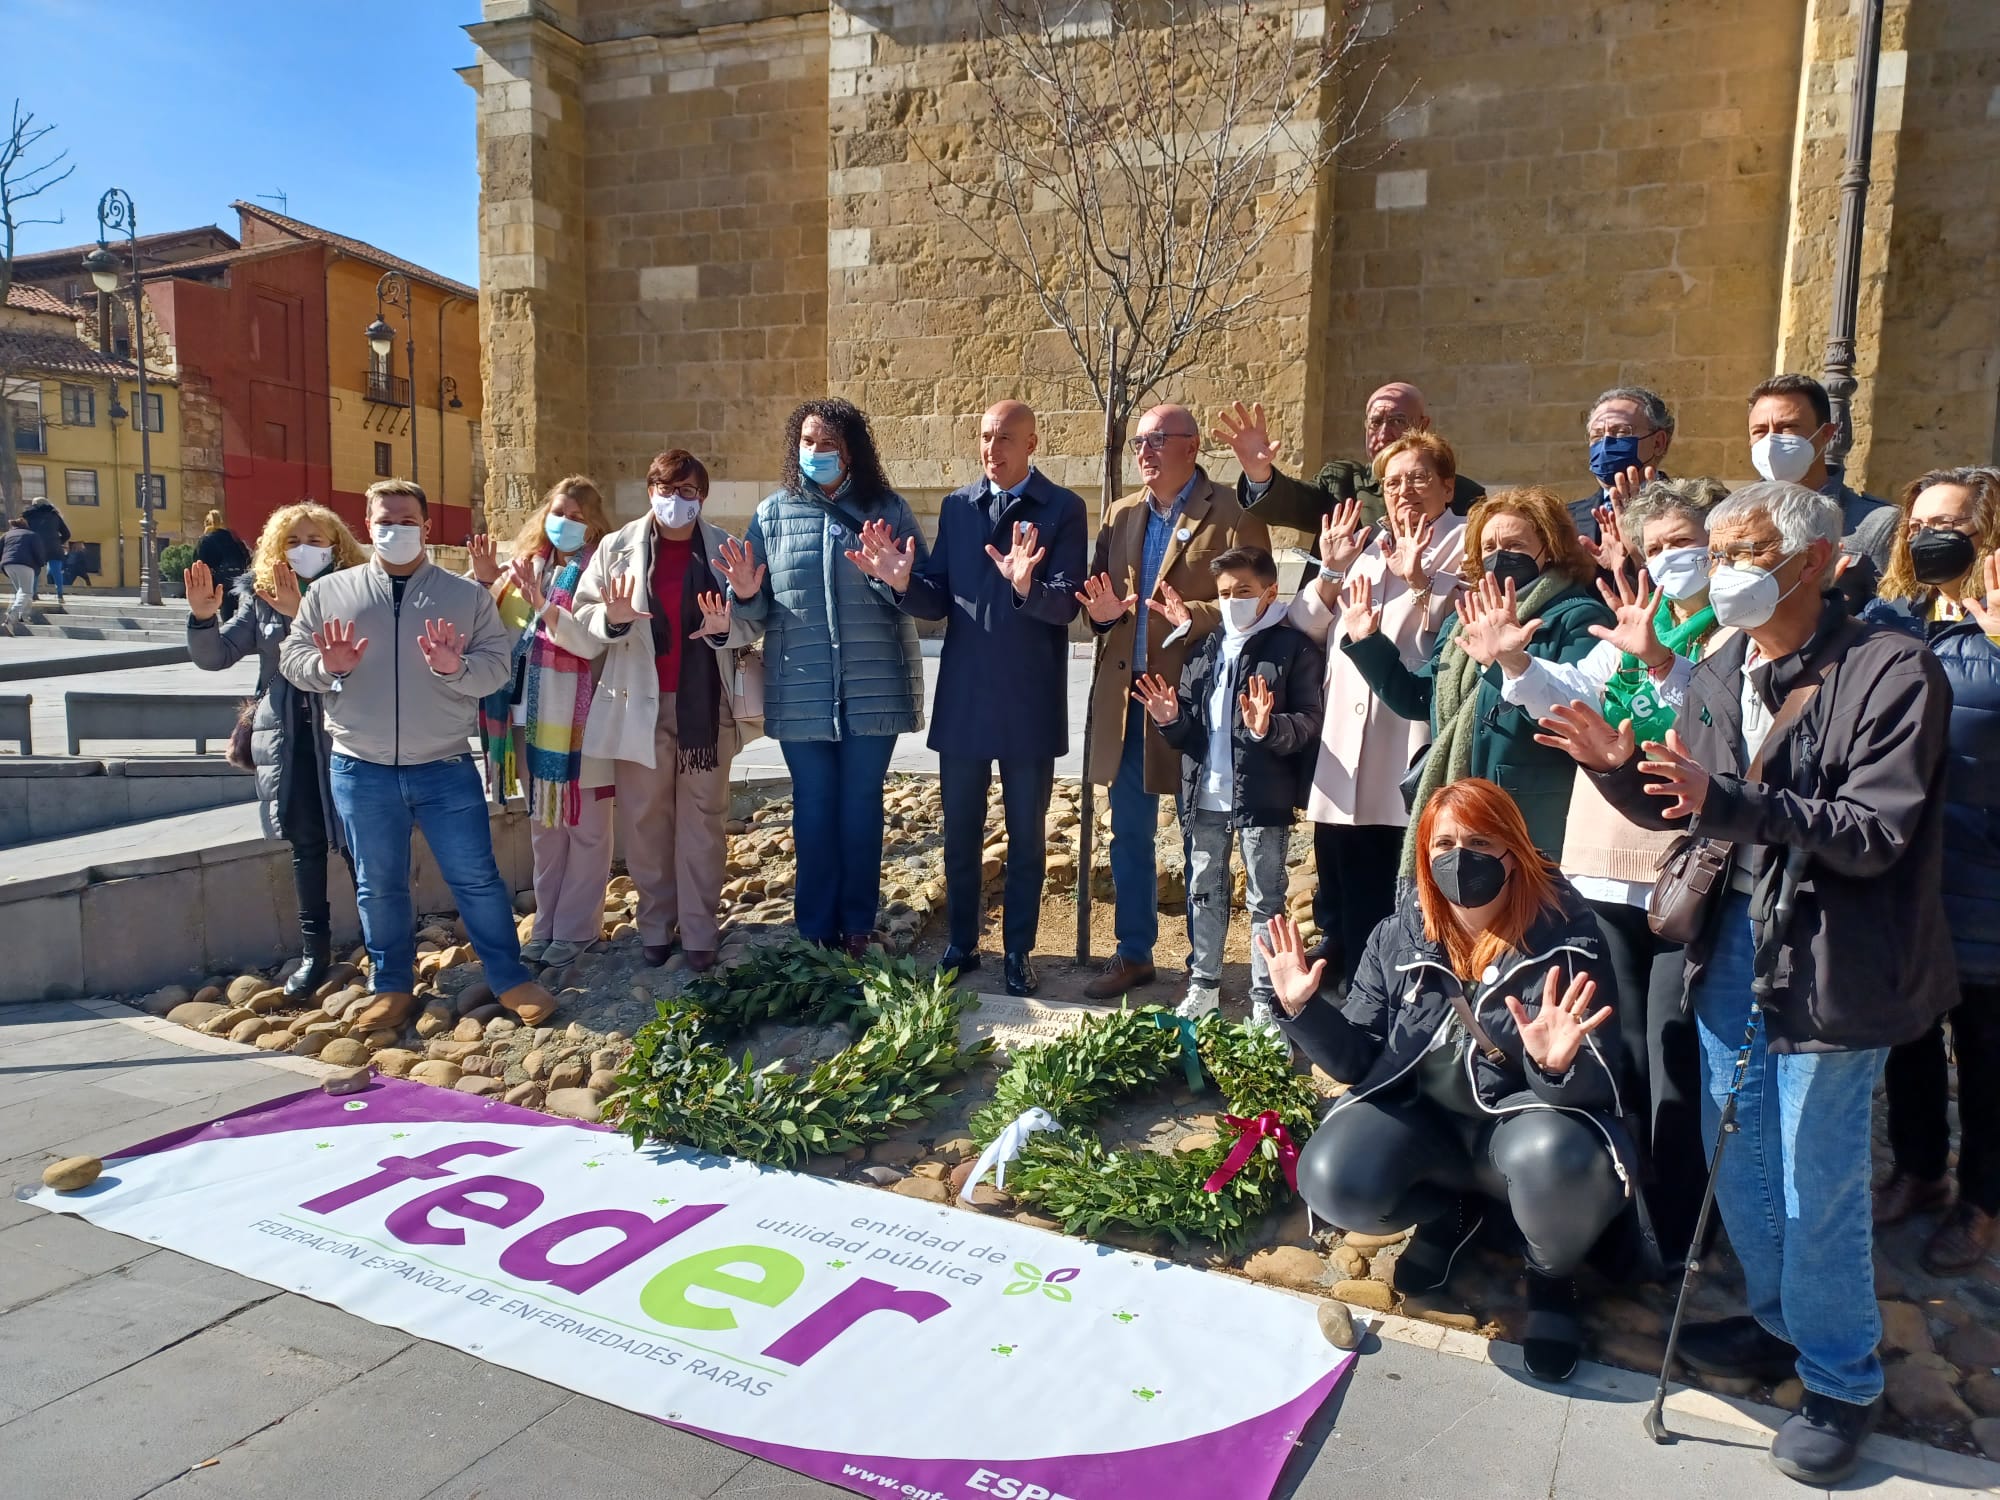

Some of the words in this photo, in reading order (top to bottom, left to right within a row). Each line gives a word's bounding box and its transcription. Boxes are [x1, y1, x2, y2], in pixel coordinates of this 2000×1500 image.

[299, 1140, 951, 1367] feder
[755, 1217, 870, 1254] utilidad
[864, 1247, 984, 1286] pública
[850, 1217, 966, 1254] entidad
[967, 1244, 1008, 1264] de
[248, 1219, 368, 1260] FEDERACIÓN
[361, 1255, 467, 1295] ESPAÑOLA
[465, 1288, 505, 1308] DE
[499, 1299, 684, 1366] ENFERMEDADES
[682, 1358, 774, 1397] RARAS
[843, 1463, 948, 1500] www.enf
